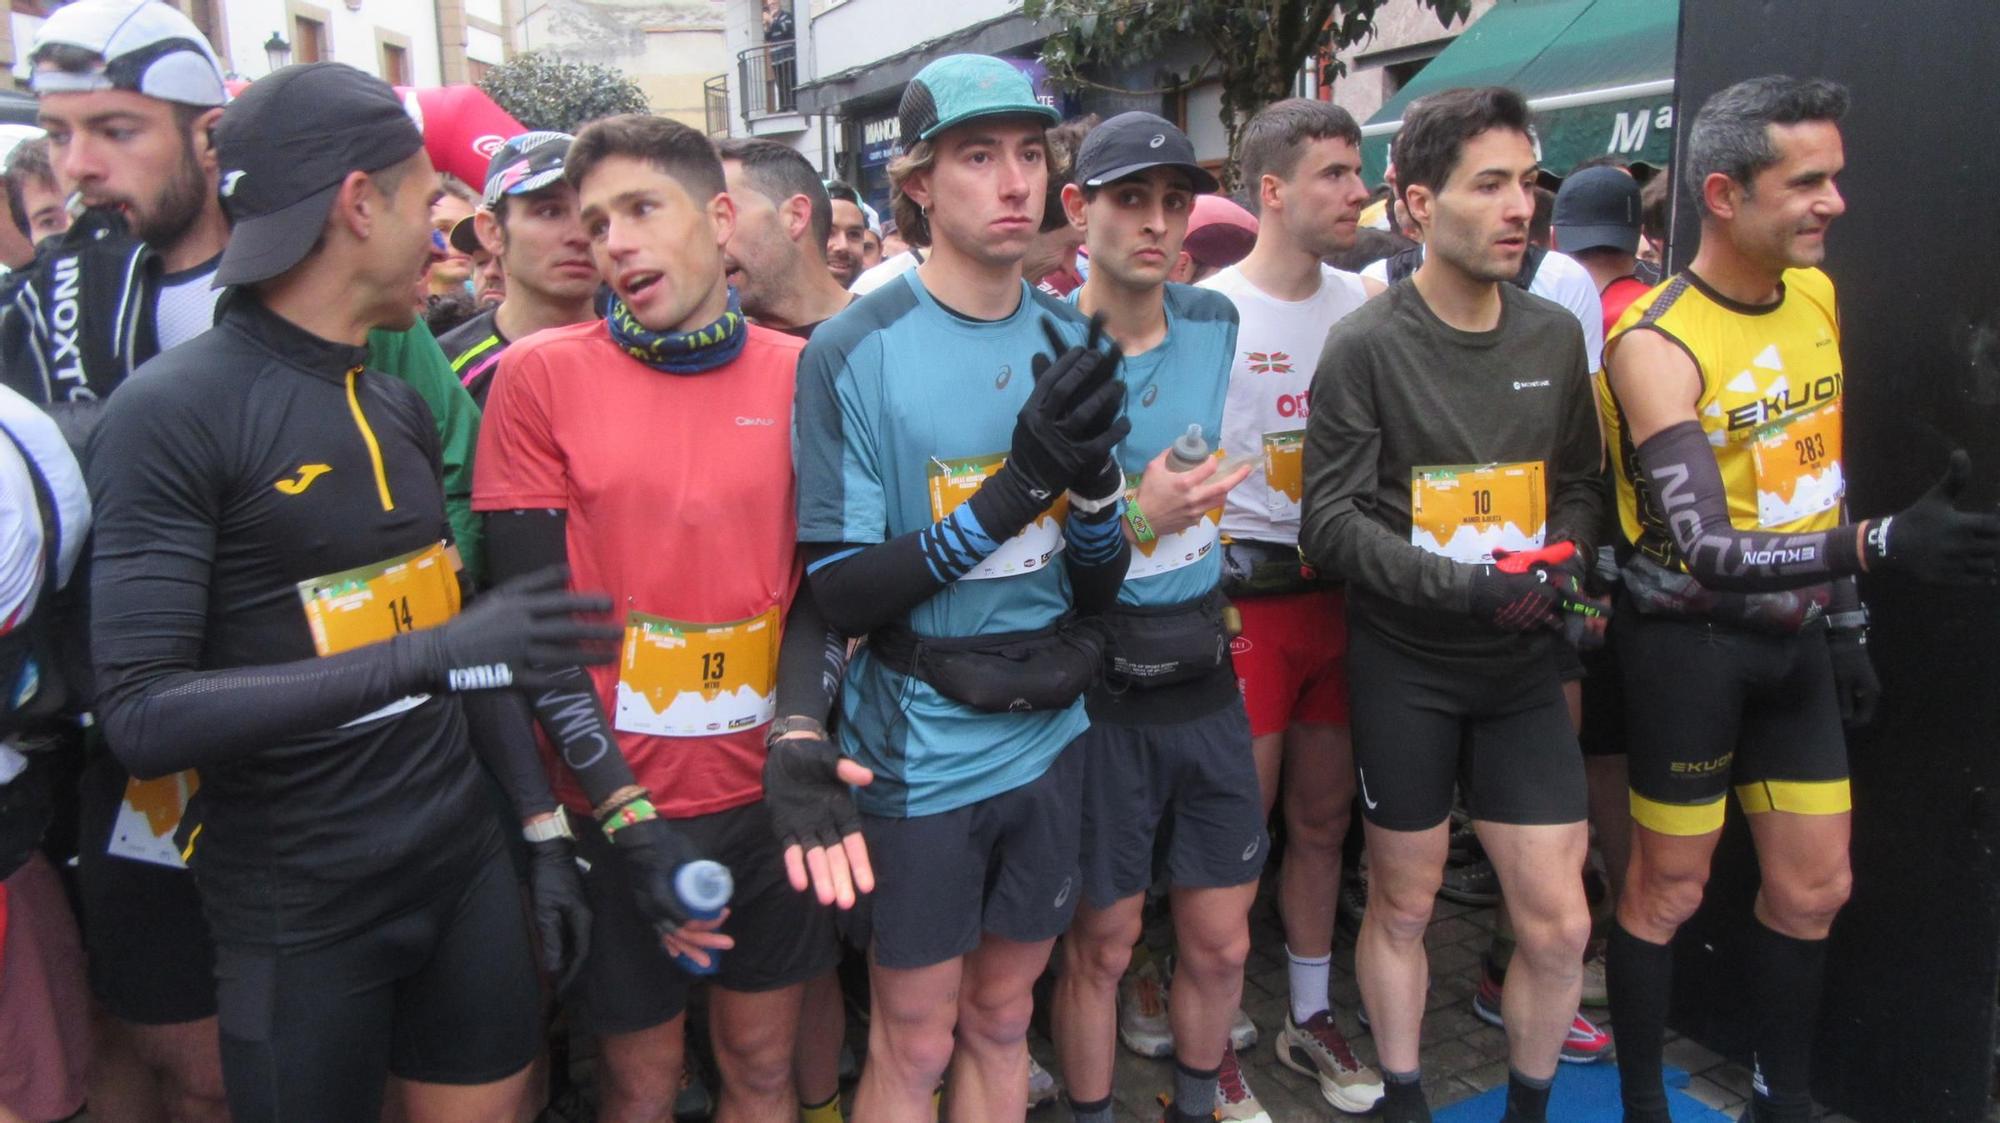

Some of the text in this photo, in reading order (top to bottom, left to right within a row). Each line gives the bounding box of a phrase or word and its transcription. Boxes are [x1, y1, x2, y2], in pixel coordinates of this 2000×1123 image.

[1795, 433, 1825, 466] 283
[1473, 490, 1490, 515] 10
[388, 596, 413, 634] 14
[701, 652, 725, 681] 13
